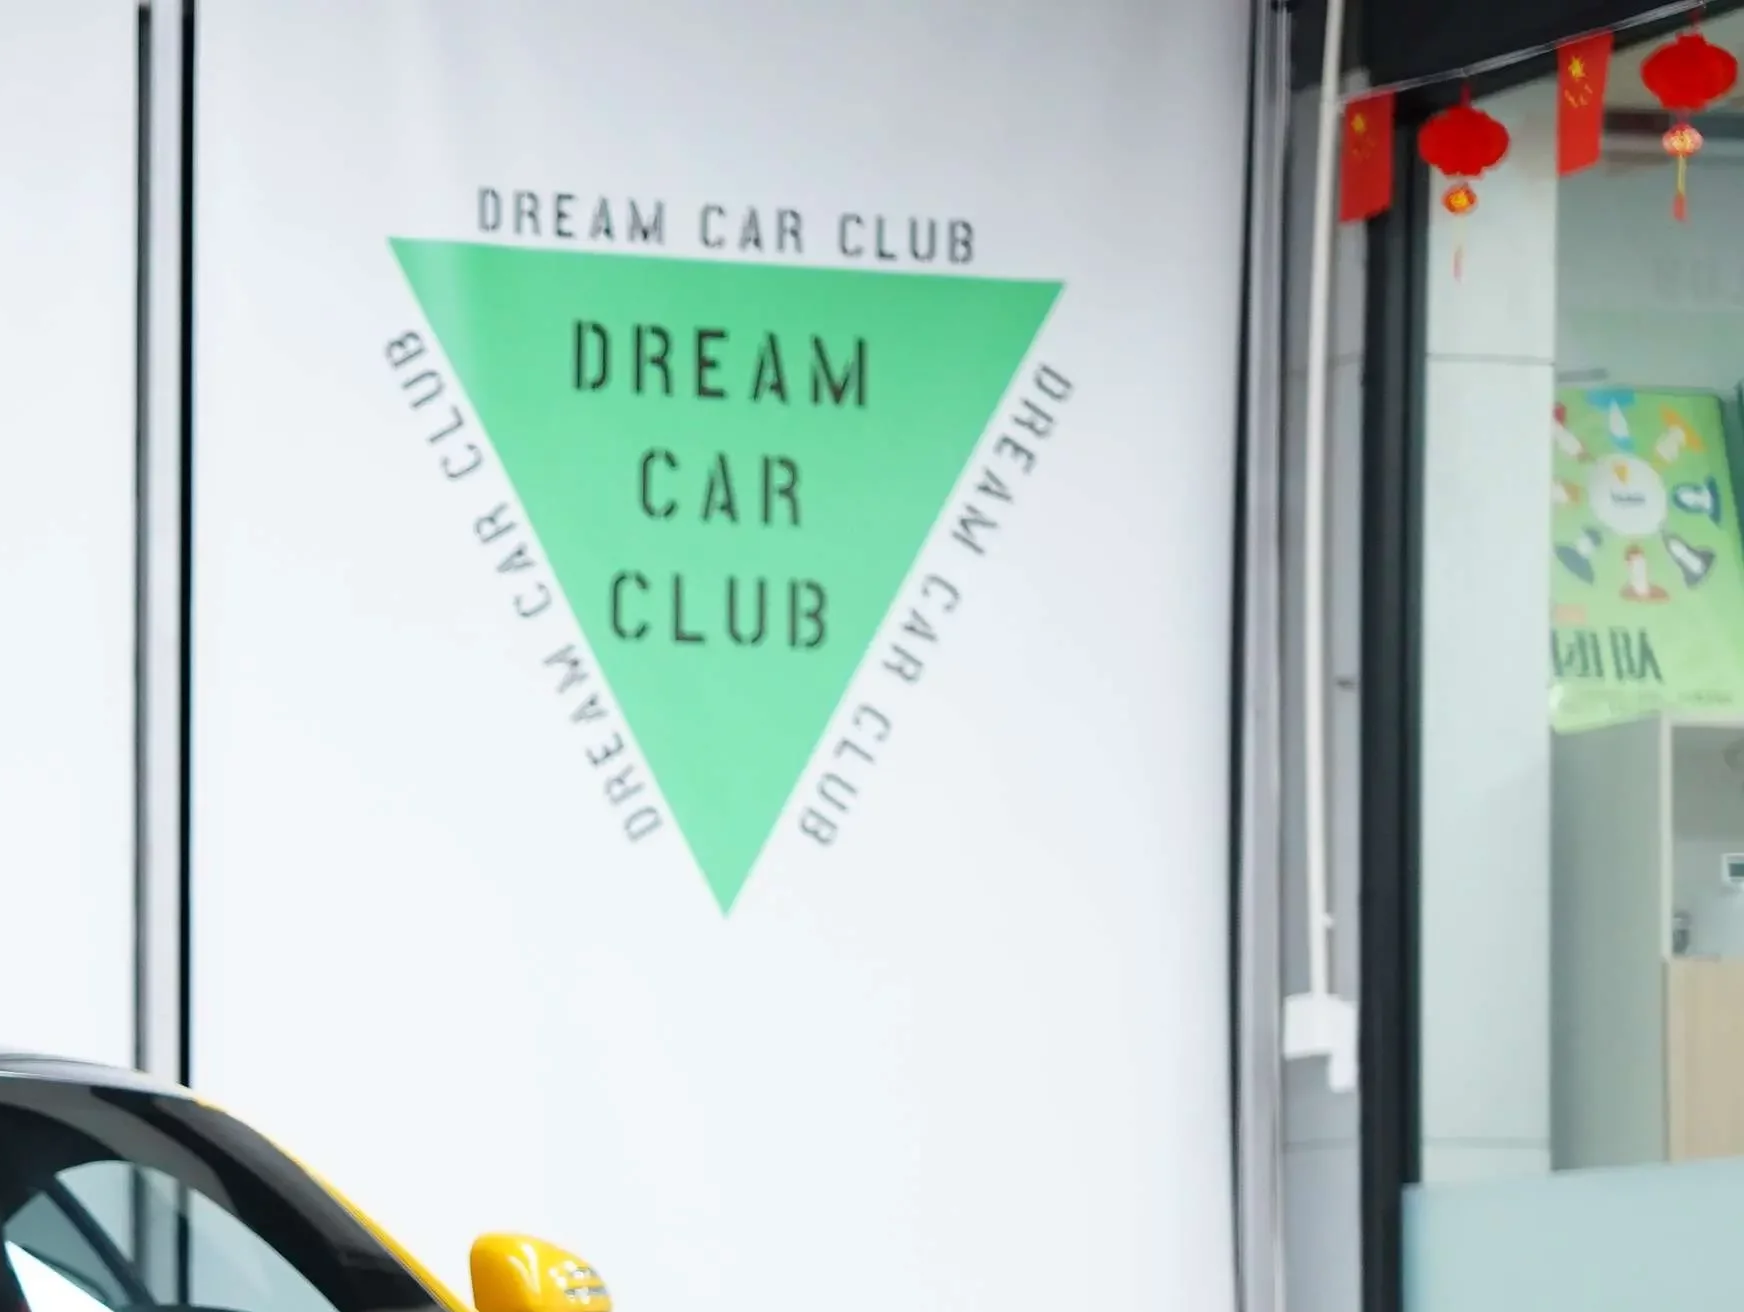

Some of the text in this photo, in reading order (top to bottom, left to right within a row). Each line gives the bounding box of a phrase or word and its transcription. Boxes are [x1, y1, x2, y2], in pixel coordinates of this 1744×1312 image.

[477, 186, 978, 266] DREAM CAR CLUB
[571, 318, 871, 409] DREAM
[636, 447, 804, 527] CAR
[383, 330, 664, 844] DREAM CAR CLUB
[608, 570, 830, 650] CLUB
[797, 362, 1076, 848] DREAM CAR CLUB
